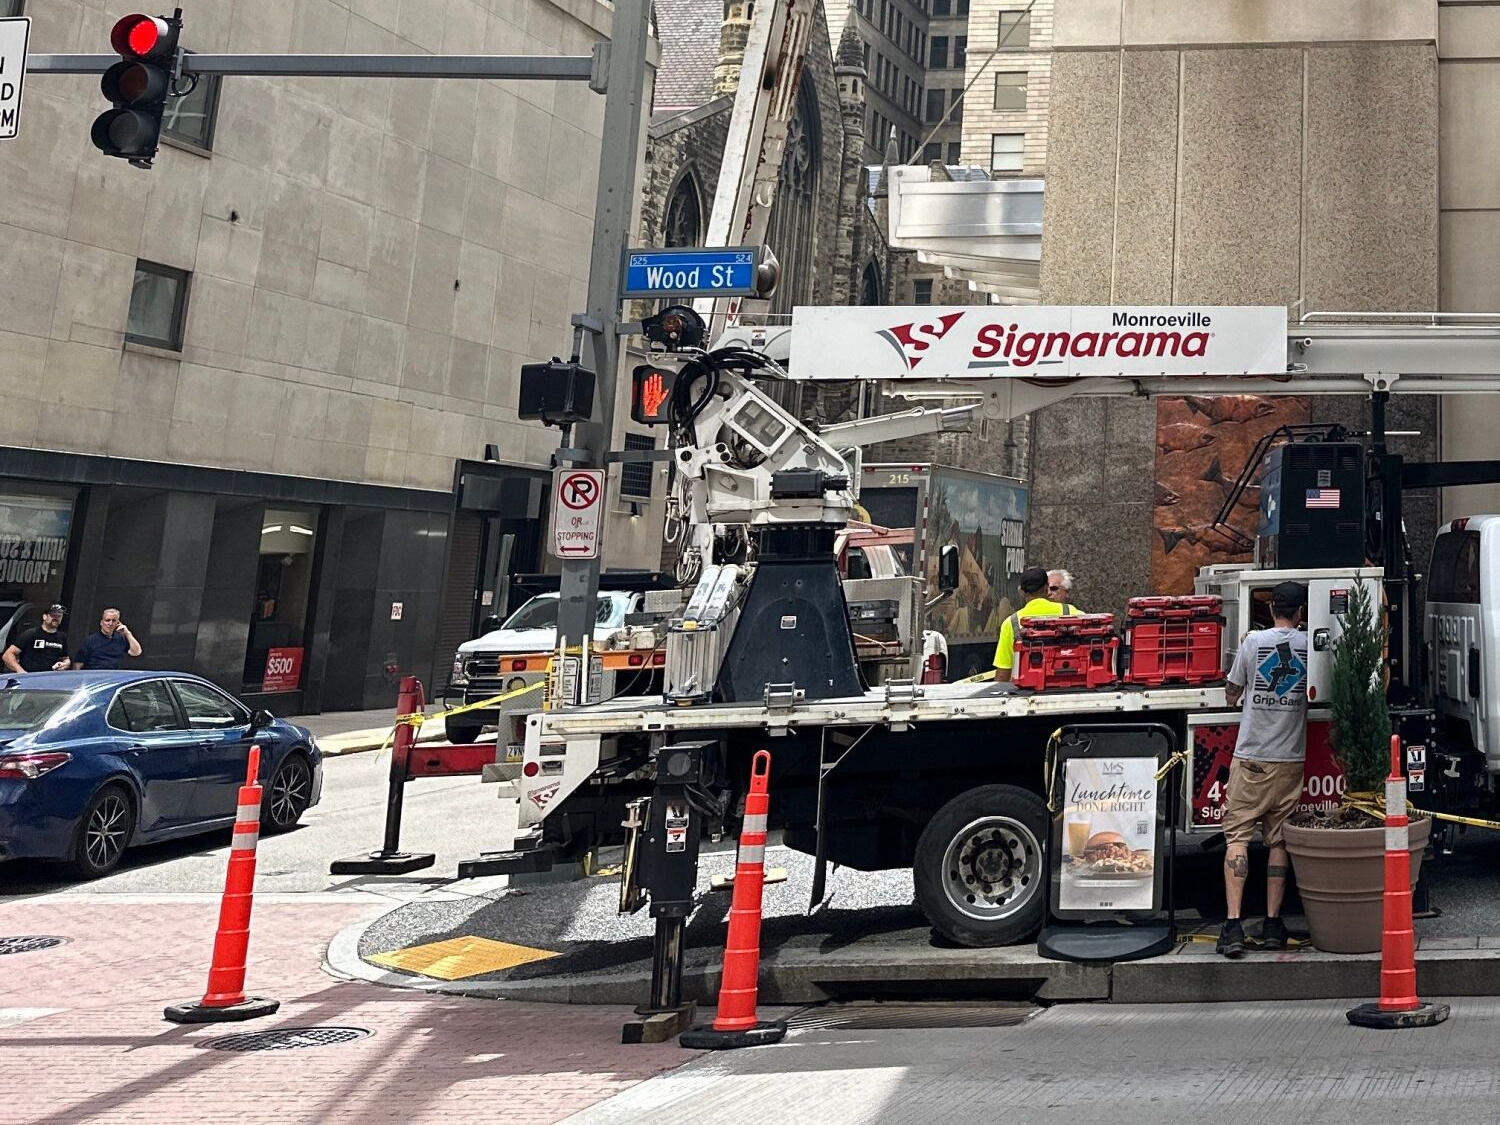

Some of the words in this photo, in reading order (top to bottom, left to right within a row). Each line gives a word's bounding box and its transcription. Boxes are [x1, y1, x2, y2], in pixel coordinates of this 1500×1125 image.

[632, 256, 648, 266] 525
[735, 253, 752, 263] 524
[646, 266, 700, 289] Wood
[710, 265, 734, 287] St
[1111, 311, 1212, 328] Monroeville
[971, 323, 1210, 368] Signarama
[889, 474, 910, 484] 215
[571, 516, 582, 526] OR
[557, 531, 595, 541] STOPPING
[1071, 782, 1152, 804] Lunchtime
[1076, 801, 1108, 812] DONE
[1110, 801, 1146, 812] RIGHT
